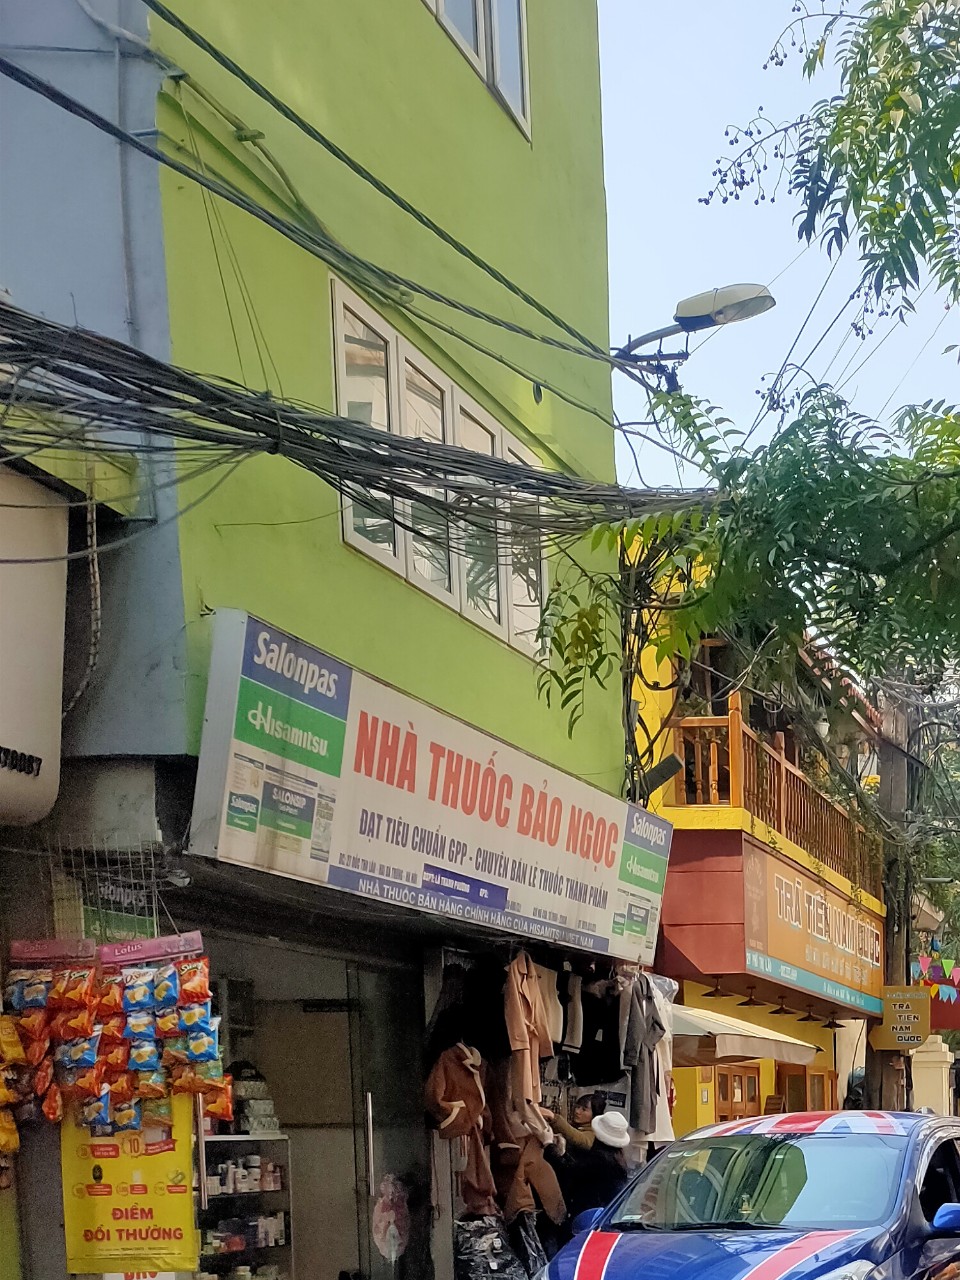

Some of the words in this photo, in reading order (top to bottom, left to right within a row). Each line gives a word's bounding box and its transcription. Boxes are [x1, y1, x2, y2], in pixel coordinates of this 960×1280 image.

[254, 631, 338, 698] Salonpas
[248, 701, 328, 757] Hisamitsu
[353, 710, 418, 794] NHÀ
[428, 741, 513, 828] THUỐC
[517, 779, 563, 847] BẢO
[565, 804, 619, 873] NGỌC
[631, 813, 667, 846] Salonpas
[359, 808, 384, 843] ĐẠT
[385, 816, 410, 848] TIÊU
[411, 825, 447, 860] CHUẨN
[448, 838, 468, 866] GPP
[474, 847, 510, 880] CHUYÊN
[510, 857, 526, 885] BÁN
[528, 861, 538, 888] LẺ
[539, 866, 564, 897] THUỐC
[565, 875, 589, 903] THÀNH
[589, 881, 609, 910] PHẨM
[358, 878, 380, 896] NHÀ
[383, 884, 416, 904] THUỐC
[417, 893, 438, 910] BÁN
[438, 897, 463, 916] HÀNG
[465, 903, 490, 922] CHÍNH
[491, 910, 512, 928] HÃNG
[513, 916, 528, 932] CỦA
[580, 934, 594, 949] NAM
[114, 942, 143, 956] Lotus
[129, 1138, 139, 1153] 10
[83, 1224, 111, 1242] ĐỔI
[111, 1203, 154, 1220] ĐIỂM
